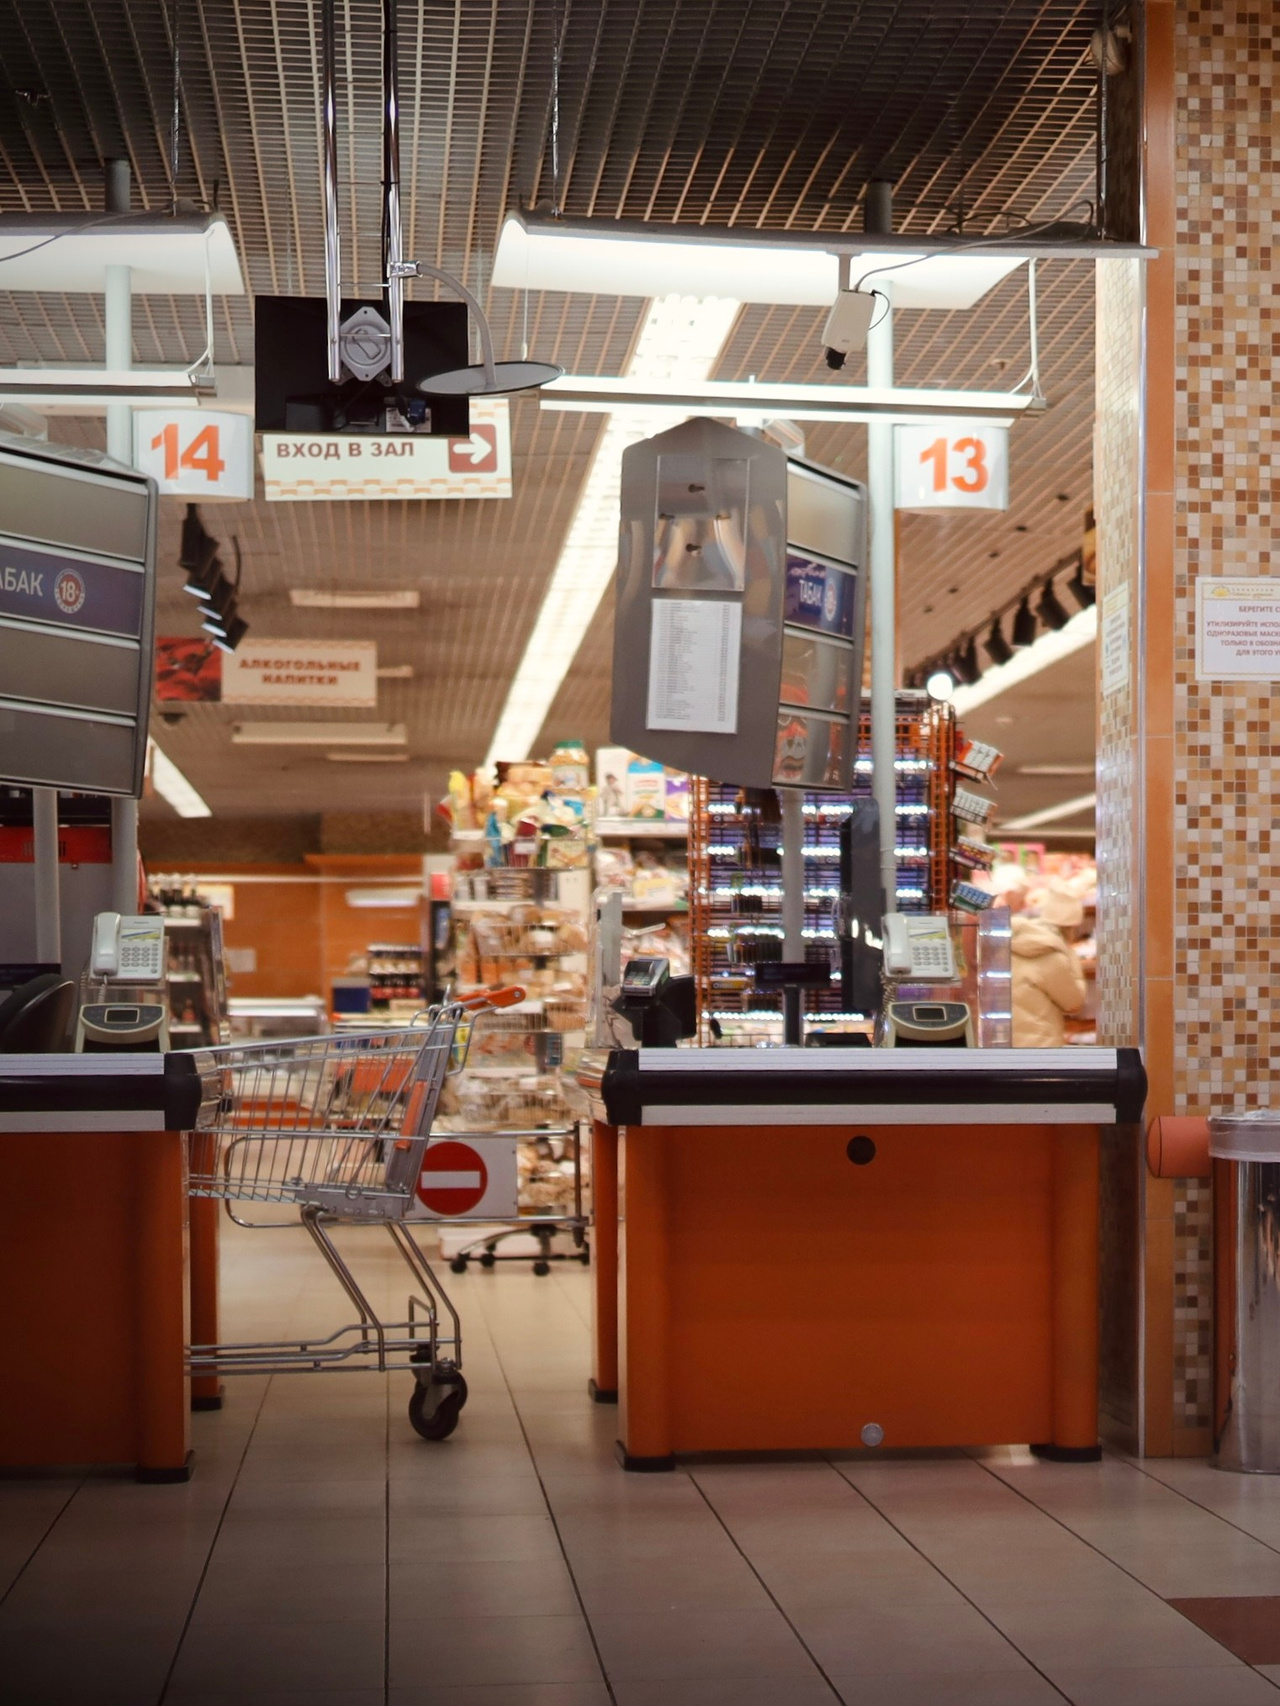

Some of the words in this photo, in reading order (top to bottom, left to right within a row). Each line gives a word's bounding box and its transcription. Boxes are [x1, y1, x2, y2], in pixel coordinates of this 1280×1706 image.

[151, 423, 226, 482] 14
[276, 442, 341, 460] ВХОД
[348, 442, 362, 457] В
[371, 441, 415, 457] ЗАЛ
[919, 437, 990, 494] 13
[0, 566, 43, 598] БАК
[1238, 605, 1274, 613] БЕРЕГИТЕ
[1206, 620, 1259, 628] УТИЛИЗИРУЙТЕ
[1206, 630, 1258, 638] ОДНОРАЗОВЫЕ
[1220, 639, 1248, 647] ТОЛЬКО
[1235, 649, 1250, 657] ДЛЯ
[1252, 649, 1274, 657] ЭТОГО
[239, 659, 361, 672] АЛКОГОЛЬНЫЕ
[262, 674, 339, 685] НАПИТКИ
